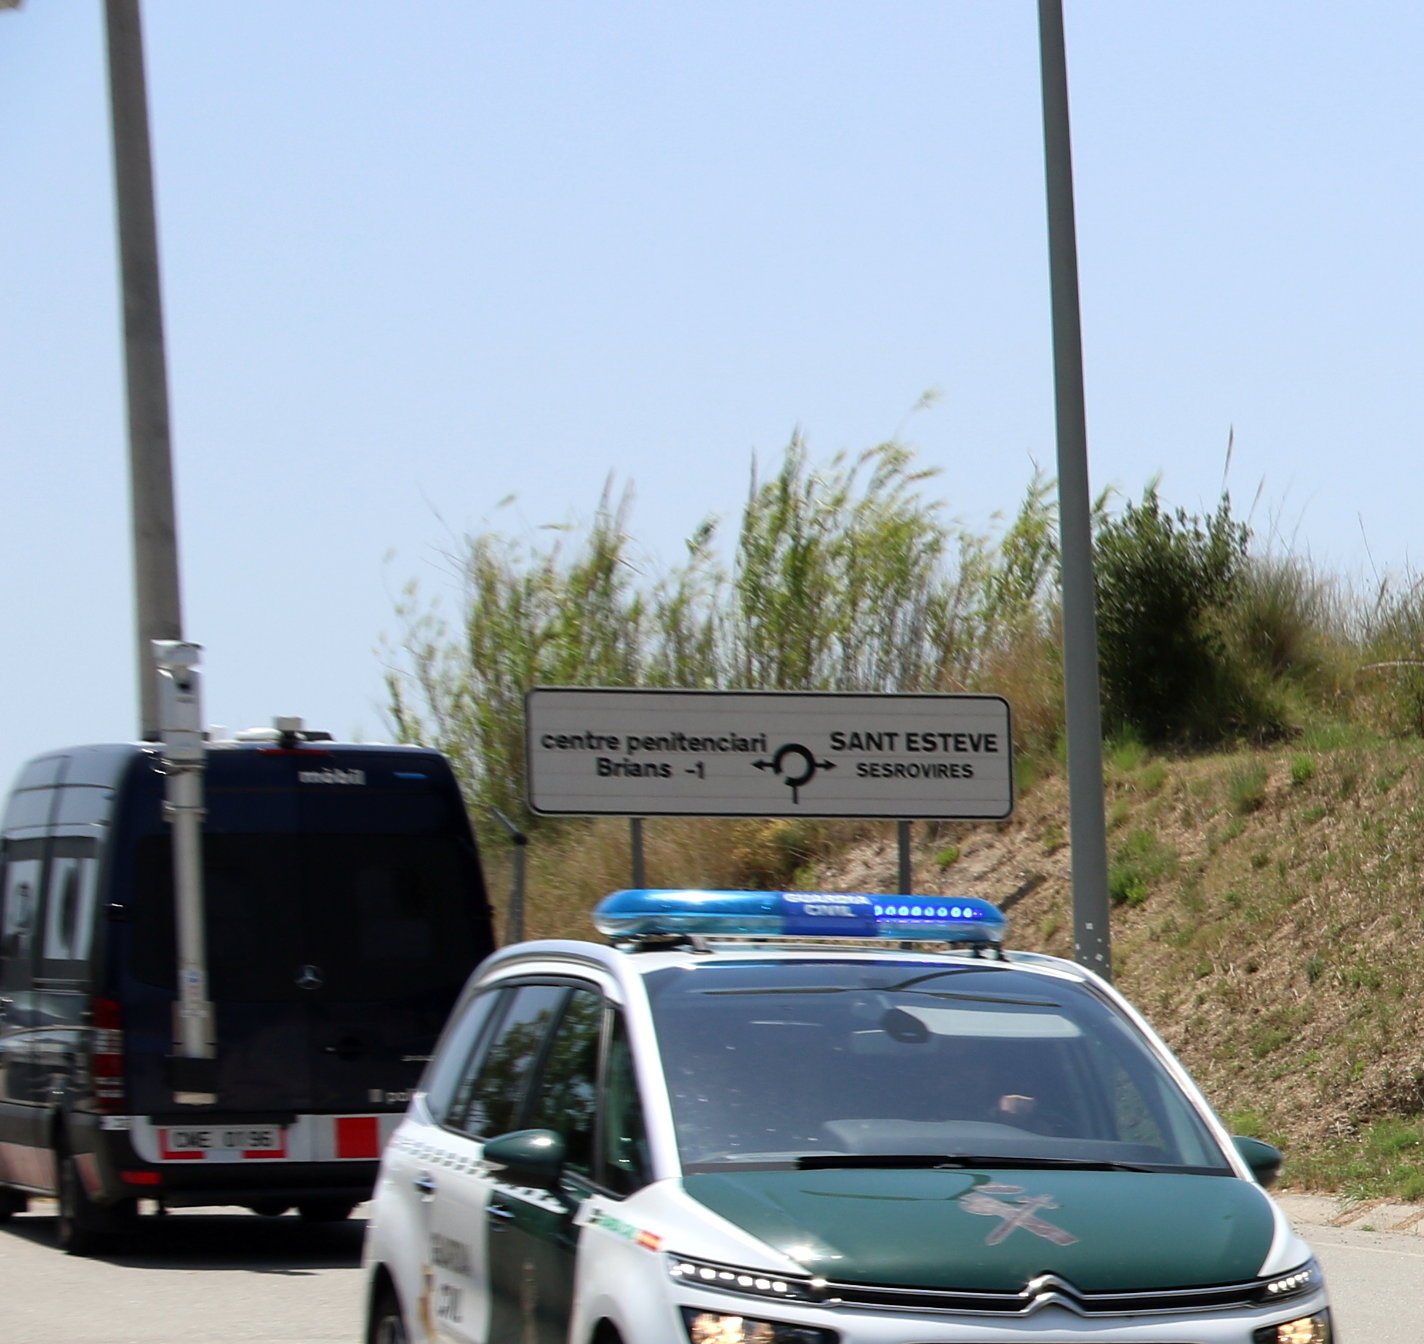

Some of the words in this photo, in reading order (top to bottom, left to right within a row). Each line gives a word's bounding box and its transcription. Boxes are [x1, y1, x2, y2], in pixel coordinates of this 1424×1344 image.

[541, 731, 620, 750] centre
[627, 731, 767, 755] penitenciari
[830, 731, 898, 751] SANT
[905, 732, 998, 753] ESTEVE
[596, 757, 672, 778] Brians
[856, 762, 974, 779] SESROVIRES
